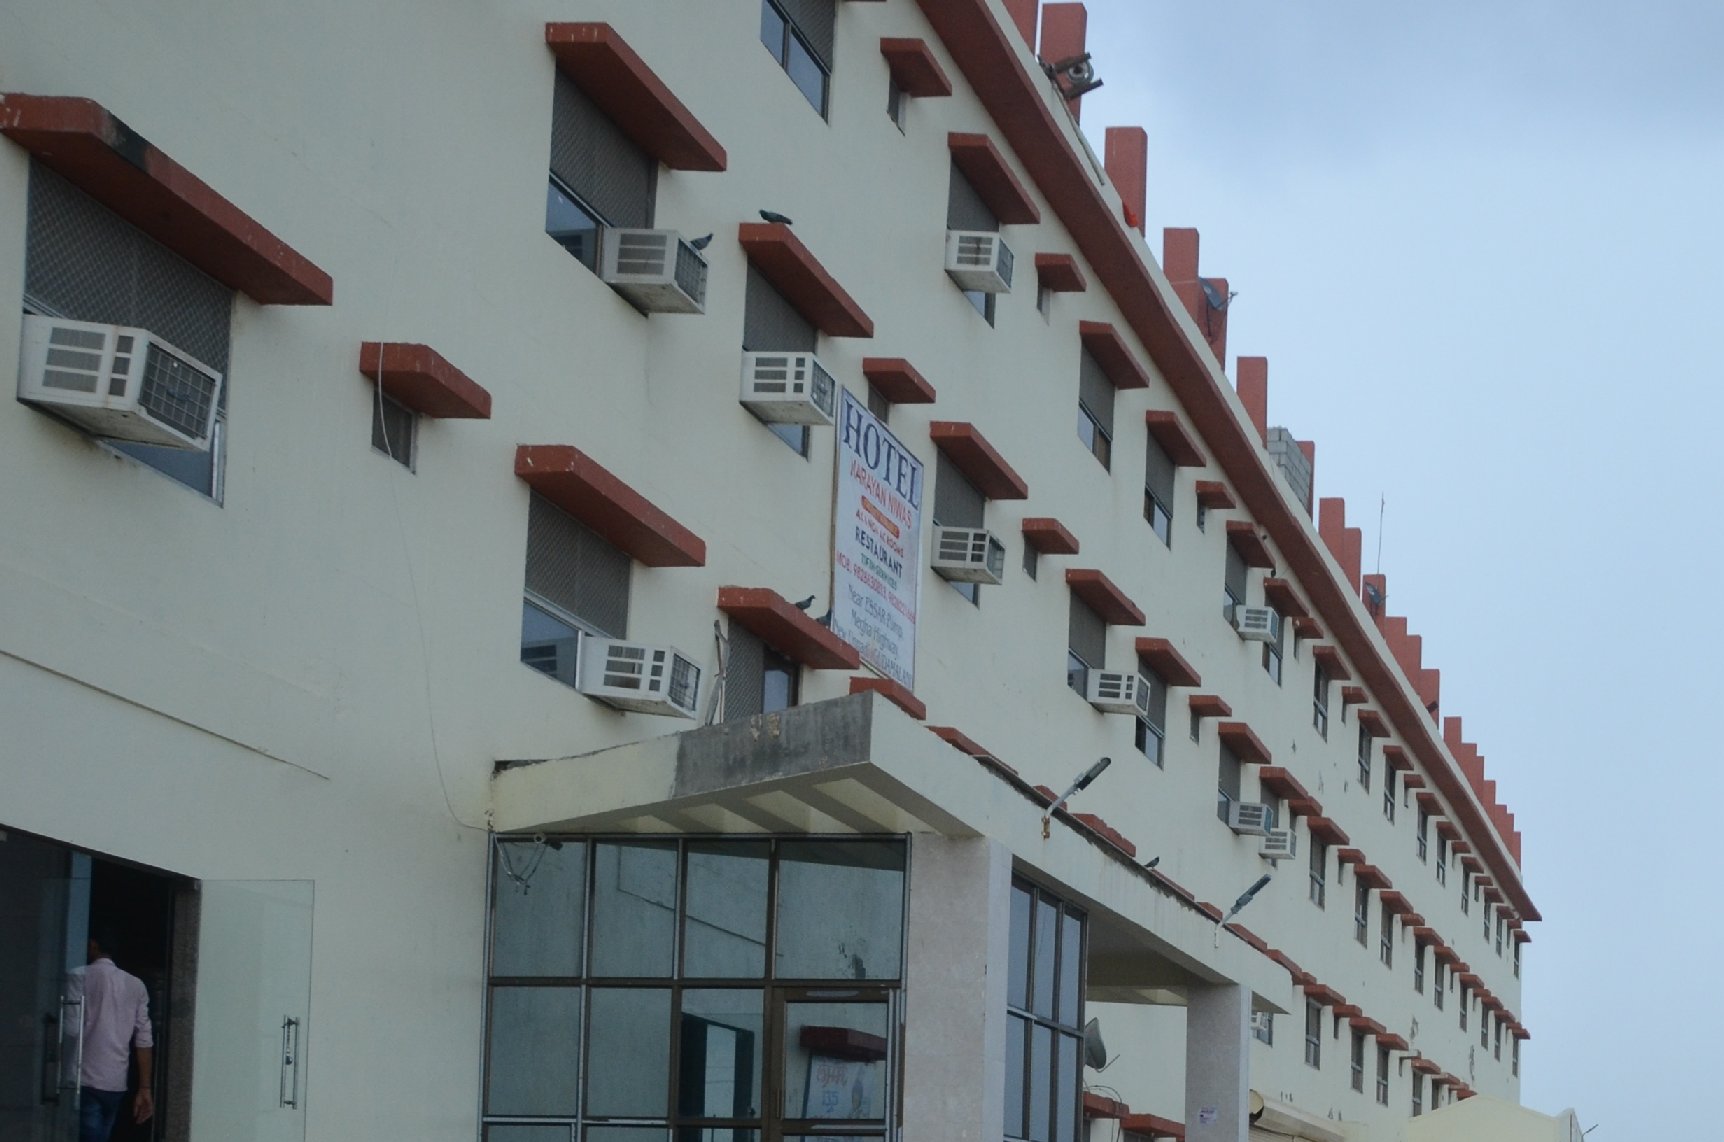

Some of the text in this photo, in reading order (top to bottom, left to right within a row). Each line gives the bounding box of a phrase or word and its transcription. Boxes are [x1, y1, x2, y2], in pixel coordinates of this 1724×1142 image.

[843, 399, 919, 511] HOTEL
[850, 459, 887, 508] NARAYAN
[888, 491, 913, 530] NIWAS
[855, 526, 903, 579] RESTAURANT
